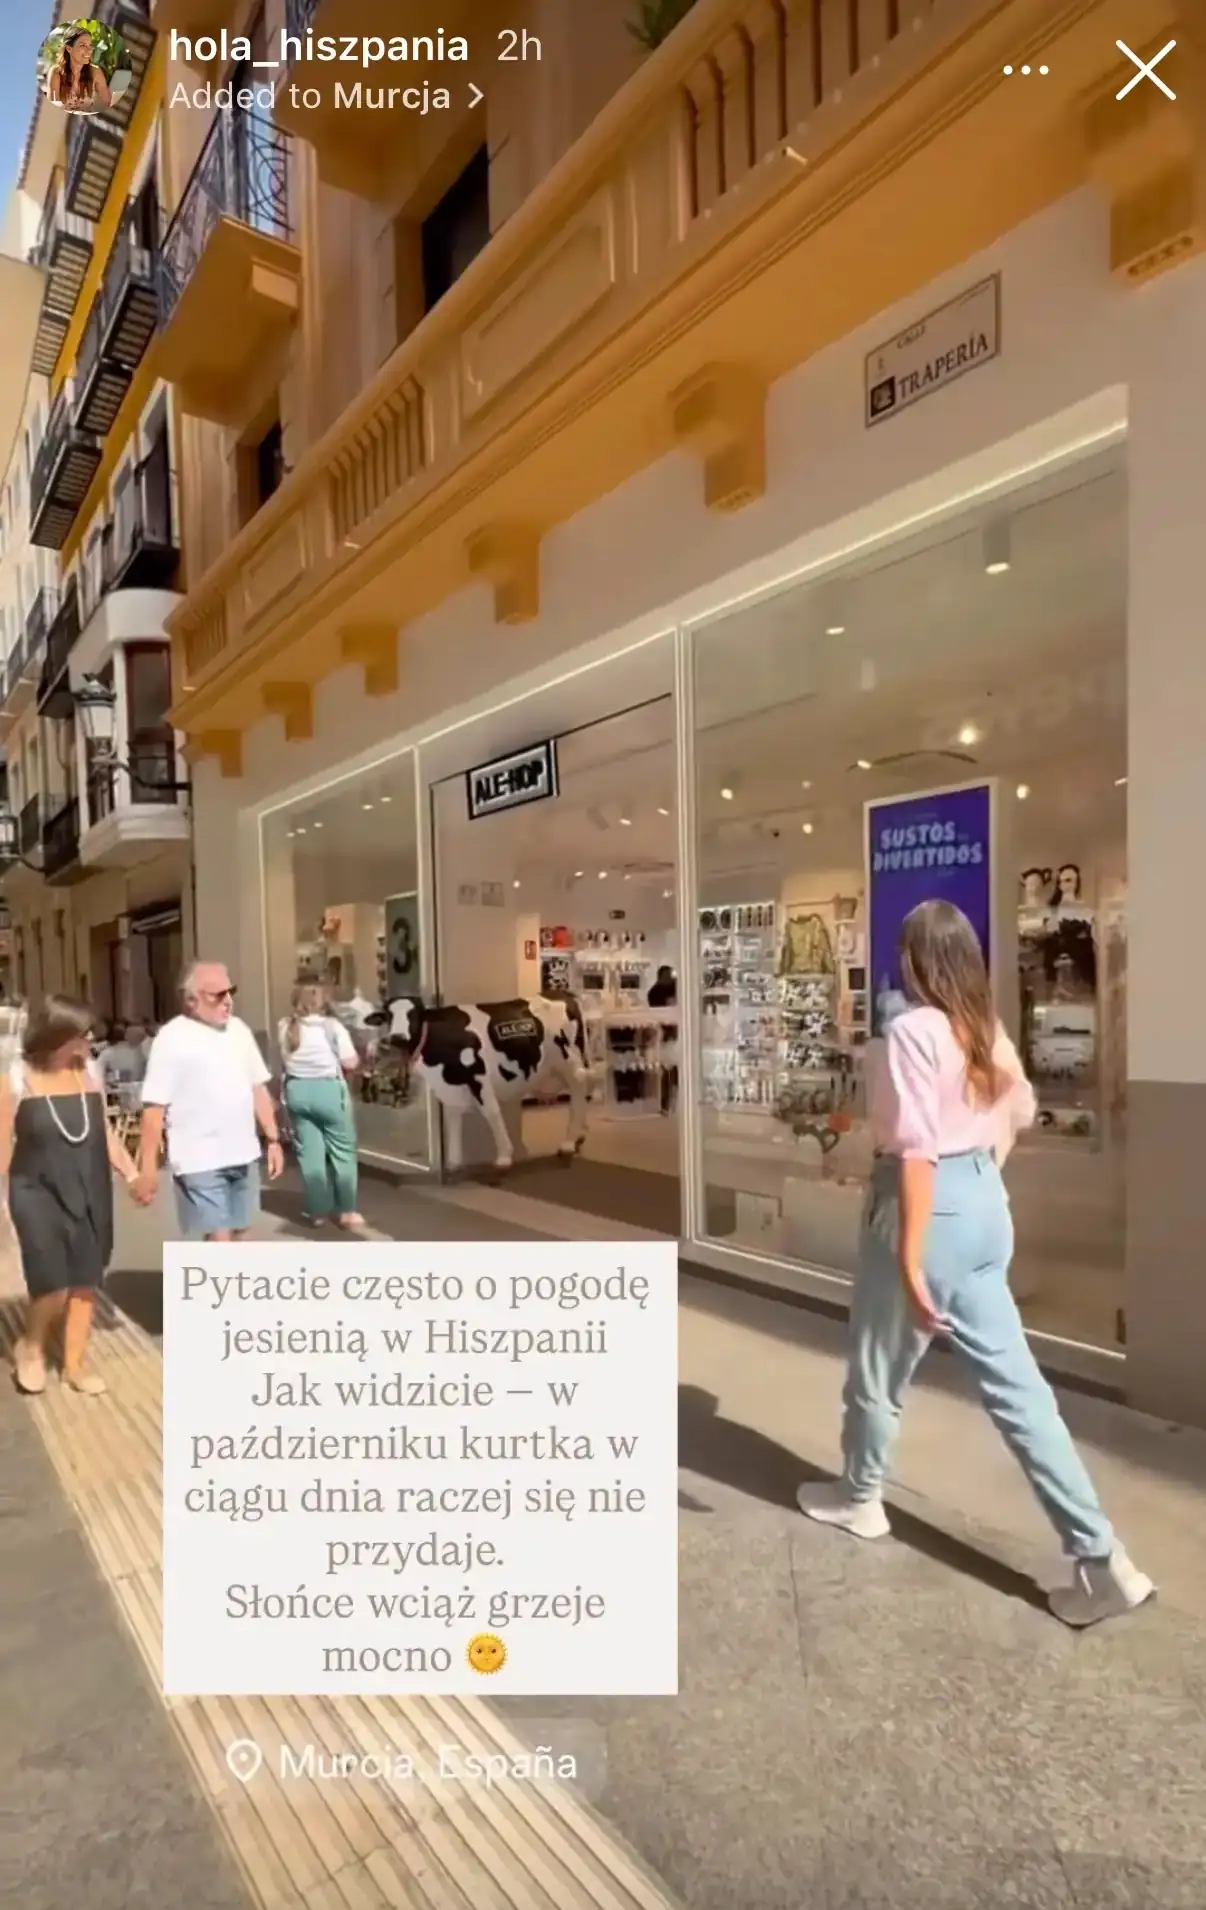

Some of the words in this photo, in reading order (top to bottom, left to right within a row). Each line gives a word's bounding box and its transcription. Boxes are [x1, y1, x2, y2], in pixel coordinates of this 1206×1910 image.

[898, 332, 989, 399] TRAPERÍA
[880, 820, 956, 850] SUSTOS
[874, 842, 982, 873] DIVERTIDOS
